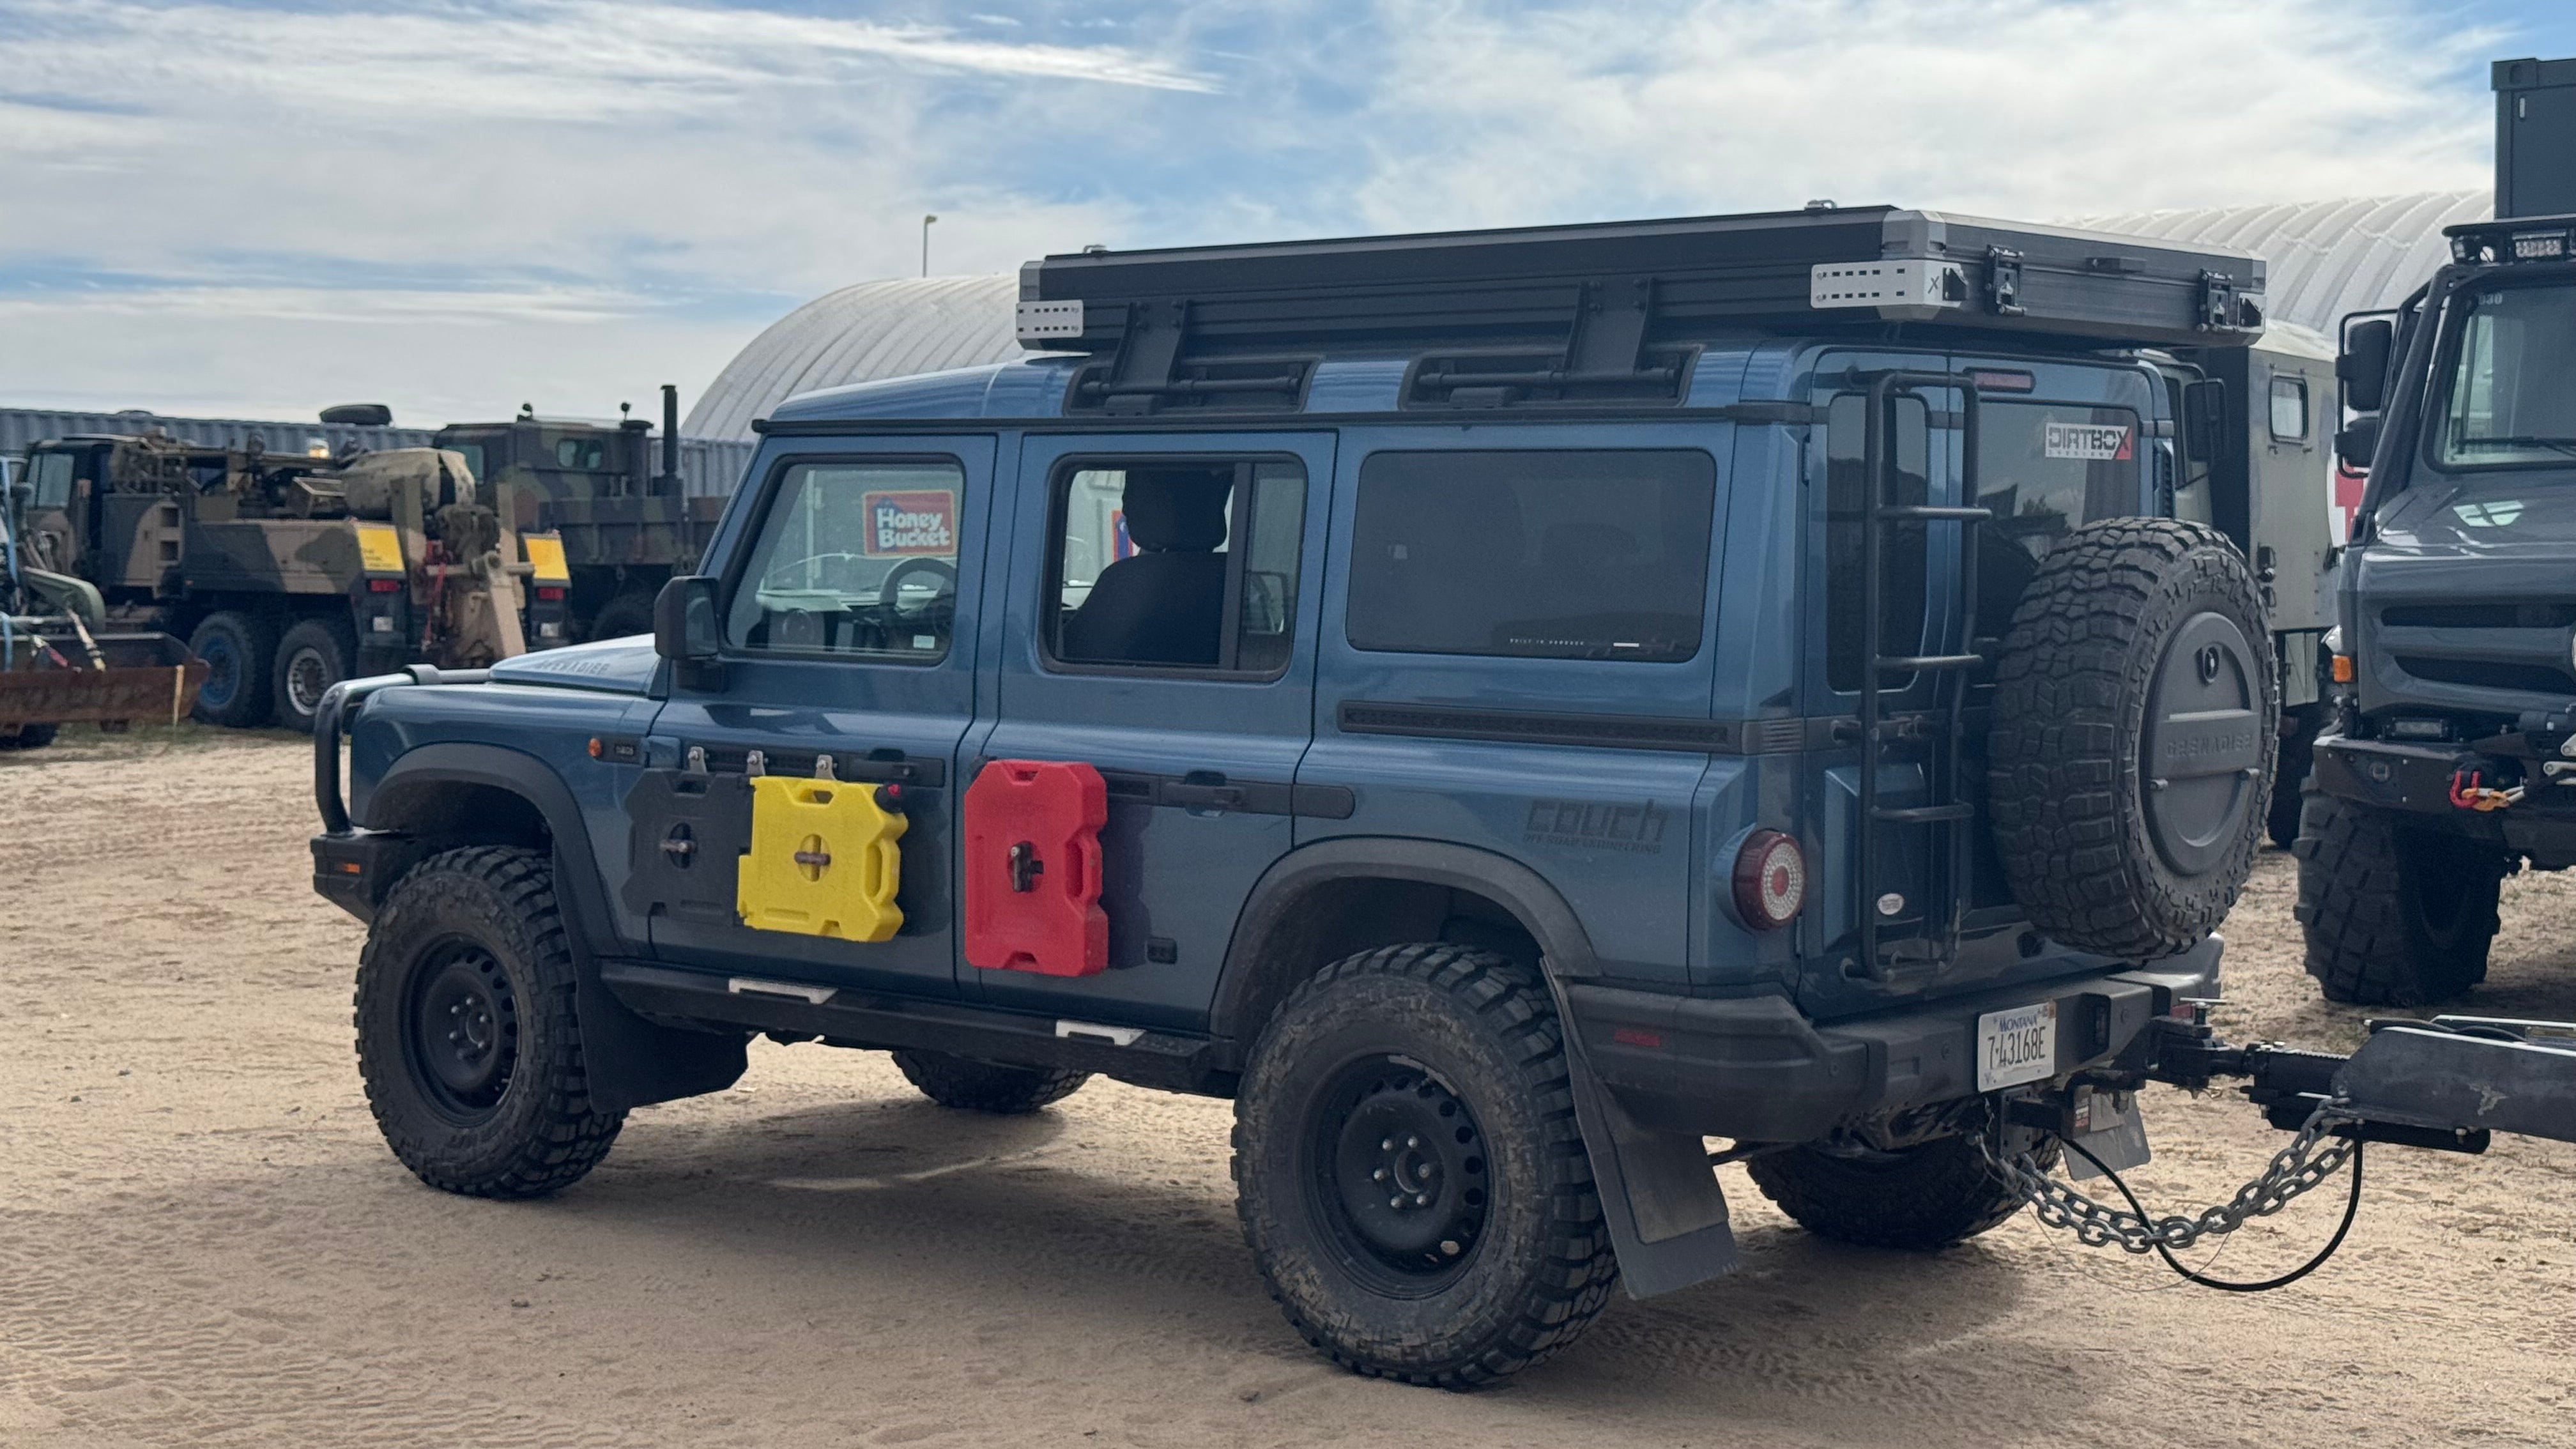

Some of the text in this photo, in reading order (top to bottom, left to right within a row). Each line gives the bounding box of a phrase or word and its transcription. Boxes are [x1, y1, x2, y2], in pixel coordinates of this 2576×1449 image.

[2048, 426, 2129, 459] DIRTBOX
[877, 507, 942, 531] Honey
[878, 527, 950, 548] Bucket
[2166, 734, 2252, 758] GRENADIER
[1999, 1015, 2037, 1032] MONTANA
